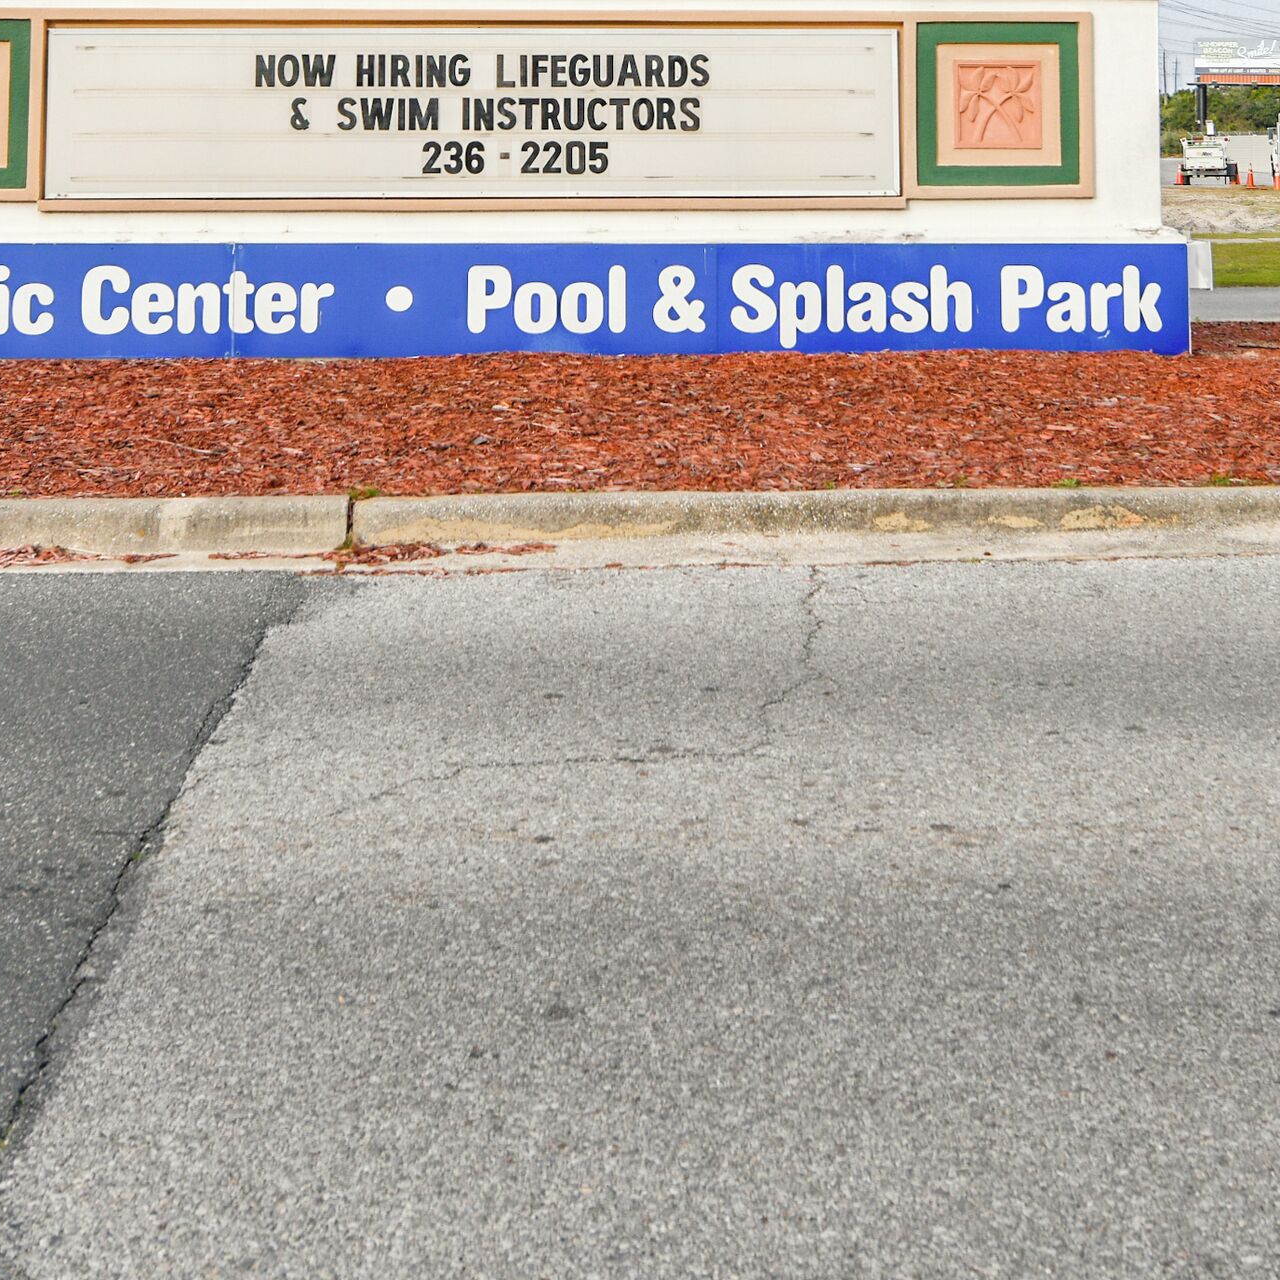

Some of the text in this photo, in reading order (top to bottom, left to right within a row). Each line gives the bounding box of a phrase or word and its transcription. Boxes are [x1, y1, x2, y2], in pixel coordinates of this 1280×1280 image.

[255, 53, 711, 88] NOW HIRING LIFEGUARDS
[290, 97, 701, 131] & SWIM INSTRUCTORS
[422, 141, 485, 174] 236
[520, 140, 609, 174] 2205
[81, 265, 334, 336] Center
[467, 264, 626, 334] Pool
[653, 264, 706, 334] &
[730, 264, 973, 349] Splash
[999, 264, 1164, 334] Park
